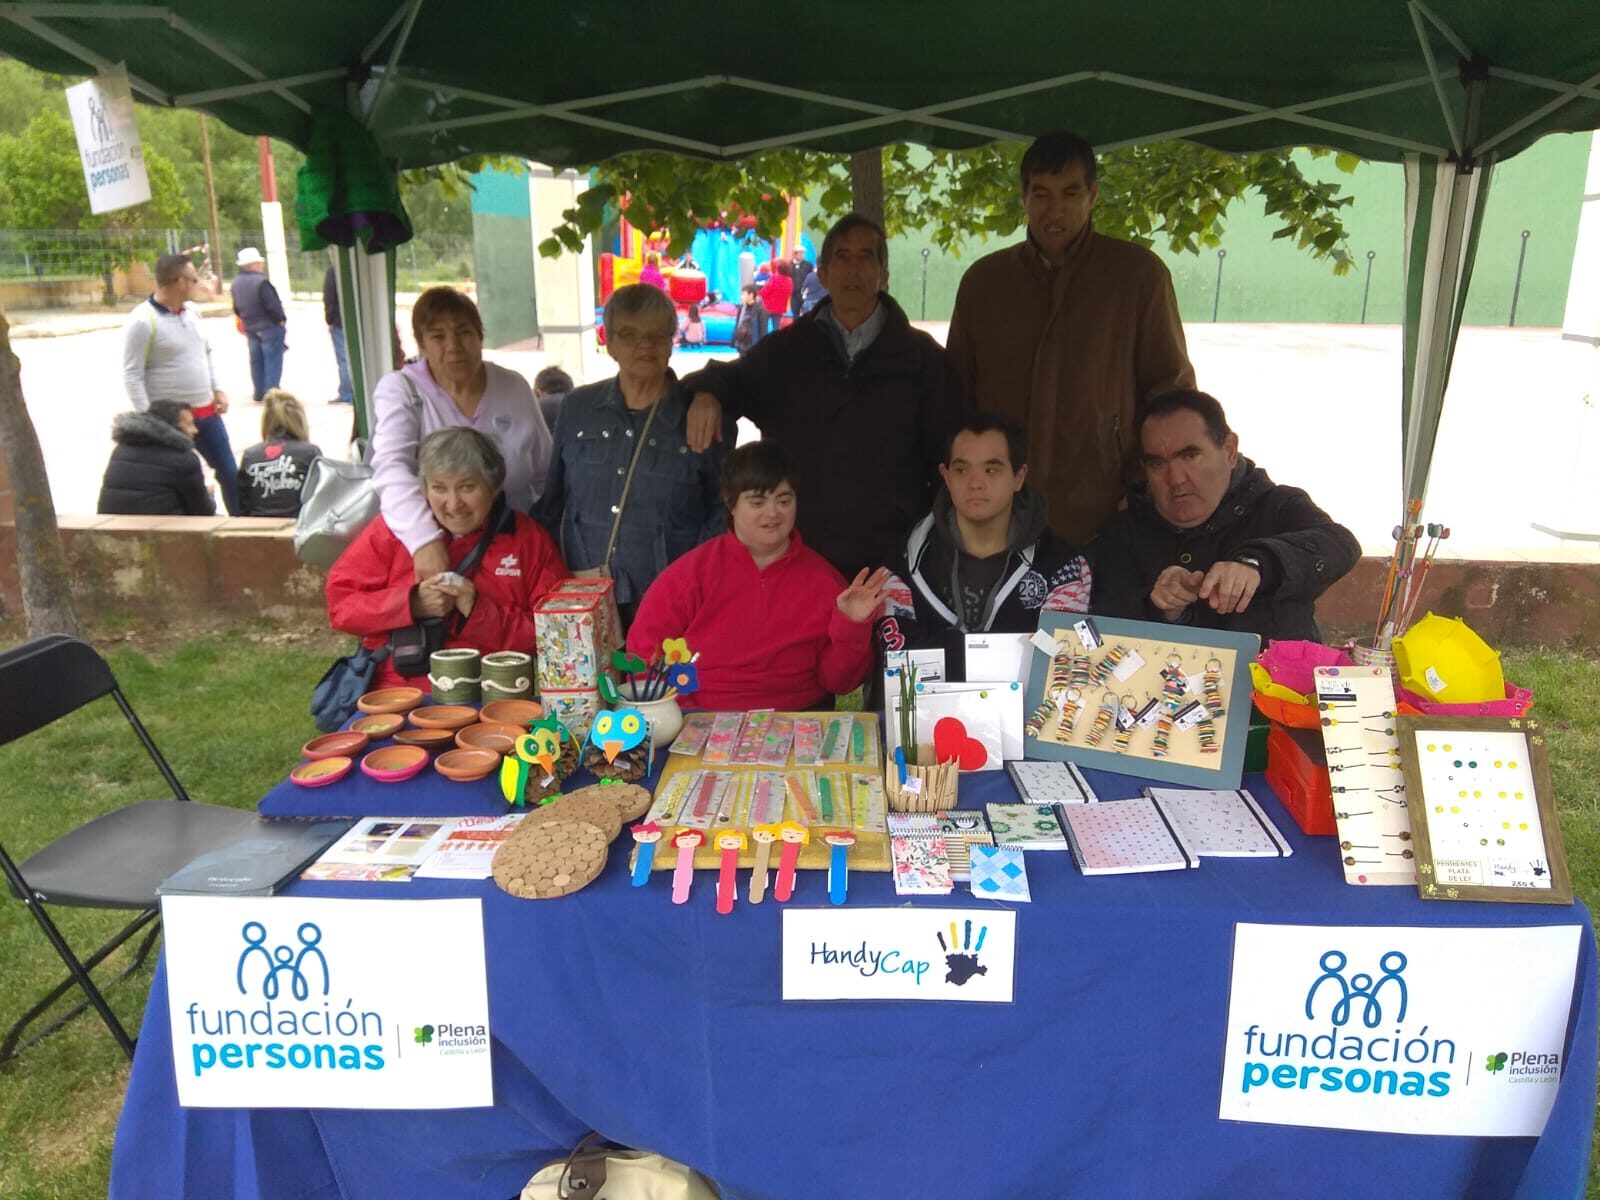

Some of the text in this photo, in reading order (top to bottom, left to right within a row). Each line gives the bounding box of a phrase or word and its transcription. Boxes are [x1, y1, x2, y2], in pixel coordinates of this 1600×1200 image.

[186, 998, 383, 1036] fundación
[438, 1023, 487, 1037] Plena
[438, 1036, 487, 1047] inclusión
[1243, 1025, 1456, 1064] fundación
[192, 1042, 385, 1077] personas
[1509, 1065, 1558, 1075] inclusión
[1510, 1051, 1559, 1066] Plena
[1242, 1062, 1451, 1097] personas
